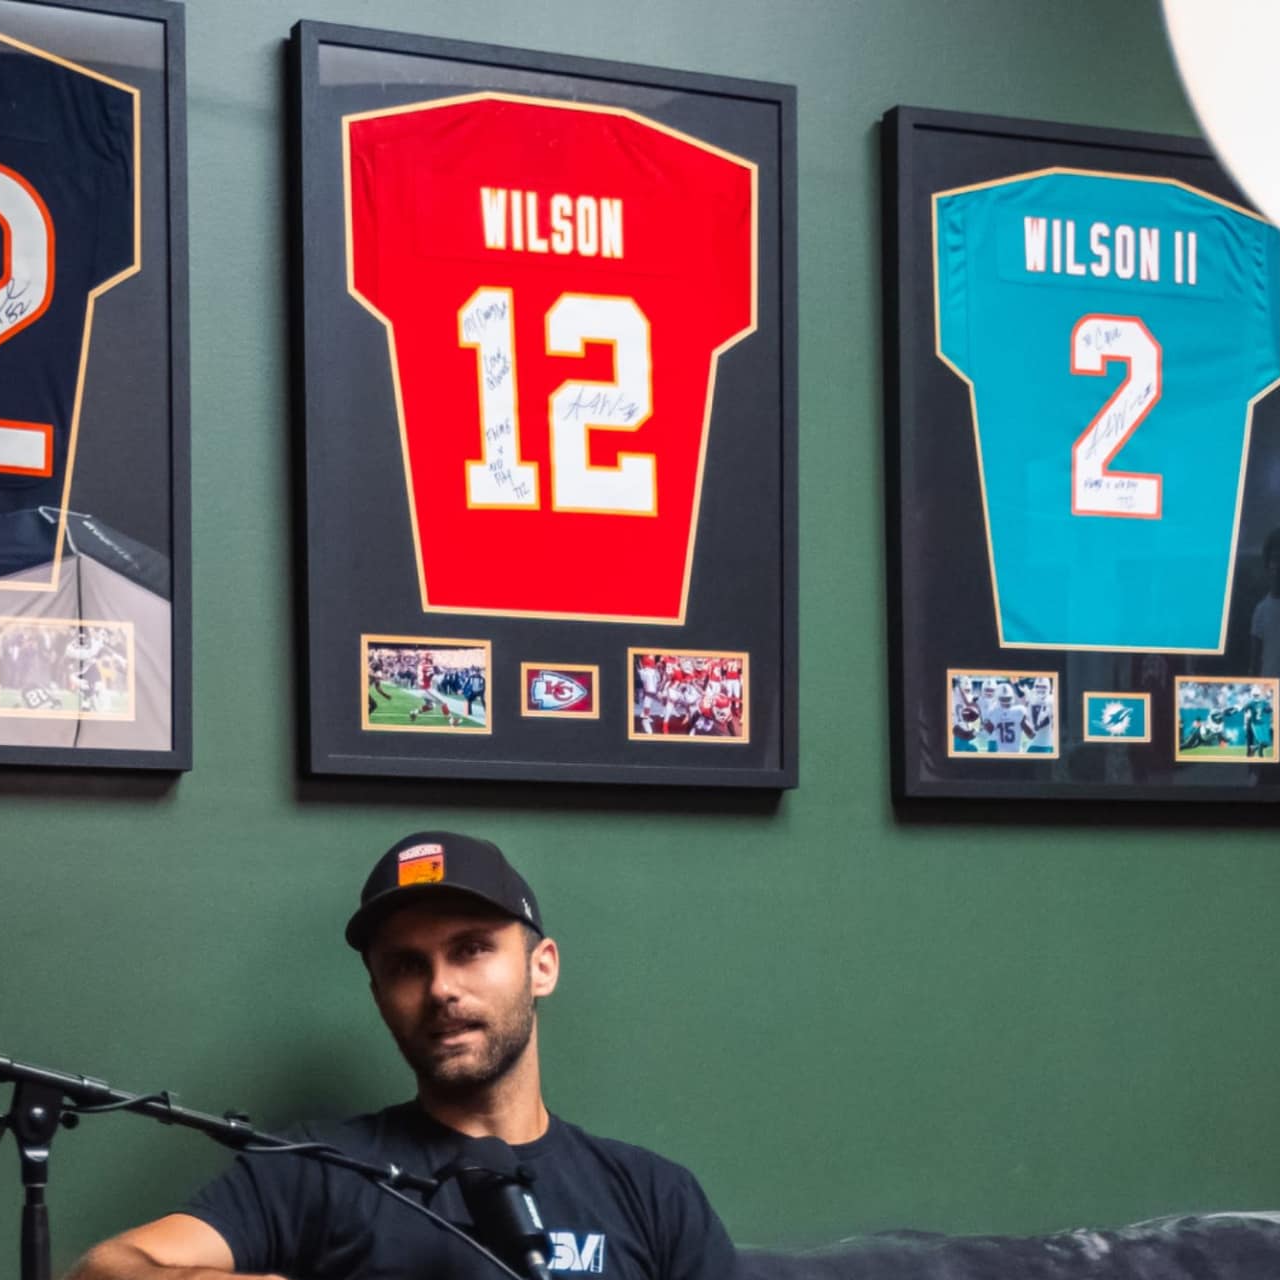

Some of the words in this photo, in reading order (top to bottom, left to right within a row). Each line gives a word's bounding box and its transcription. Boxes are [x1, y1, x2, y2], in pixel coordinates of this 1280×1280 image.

[480, 186, 624, 260] WILSON
[1023, 215, 1160, 283] WILSON
[1174, 230, 1197, 286] II
[457, 284, 659, 518] 12
[1070, 312, 1163, 521] 2
[544, 679, 574, 702] KC
[996, 721, 1016, 744] 15
